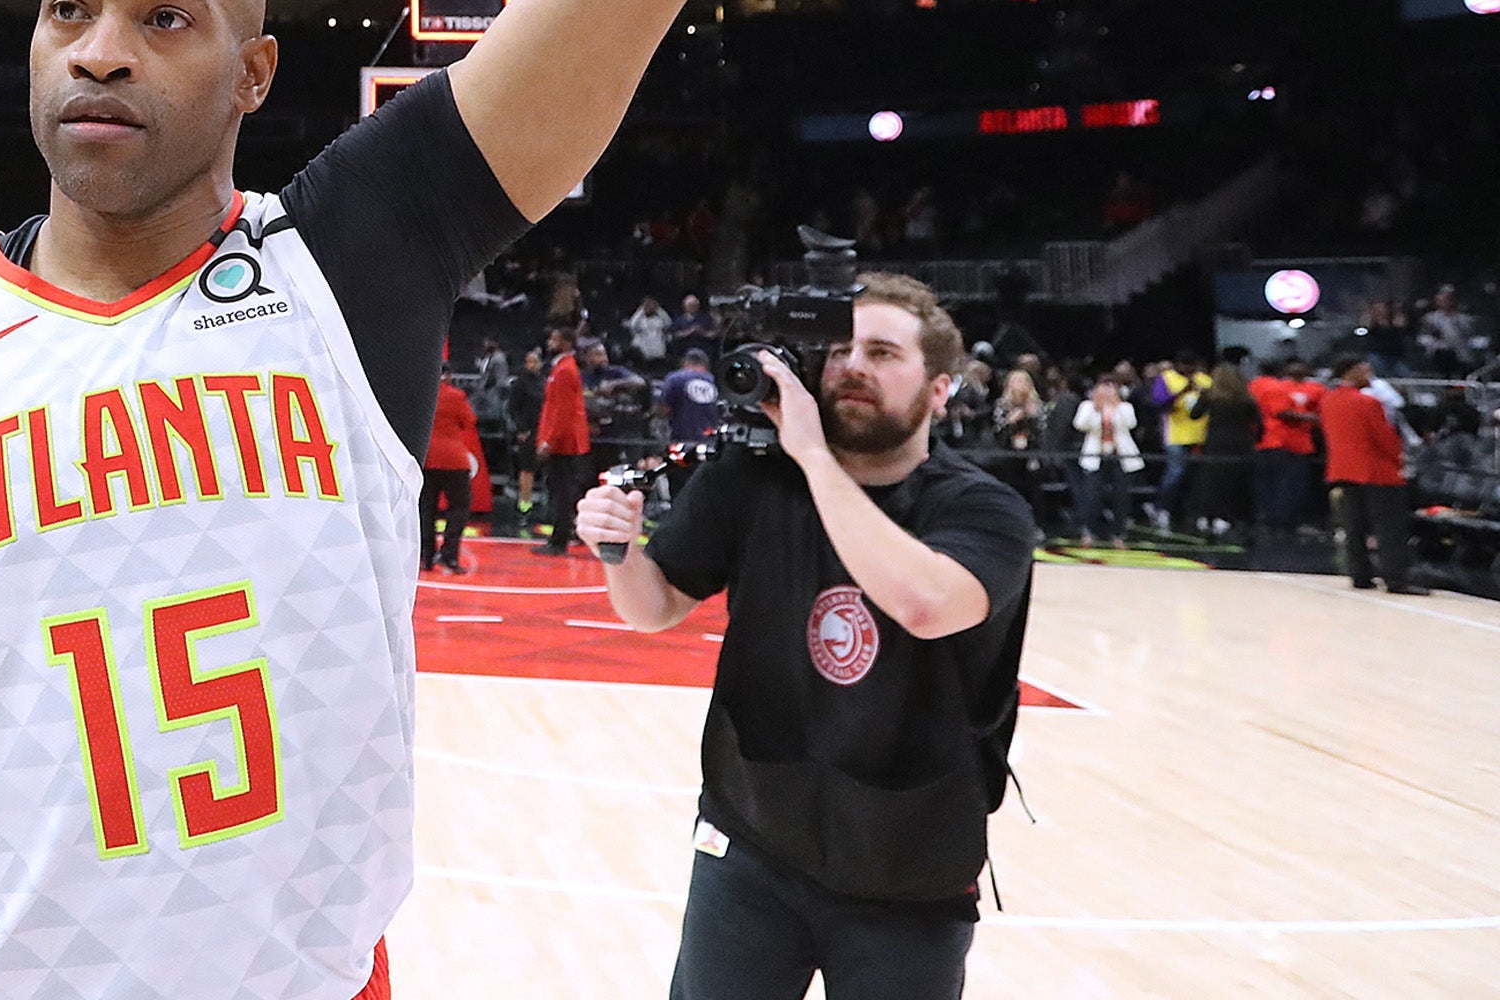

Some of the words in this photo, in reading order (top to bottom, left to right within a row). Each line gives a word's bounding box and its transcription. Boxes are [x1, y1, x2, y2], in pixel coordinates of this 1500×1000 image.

[444, 16, 496, 30] TISSO
[193, 301, 288, 330] sharecare
[40, 578, 285, 860] 15
